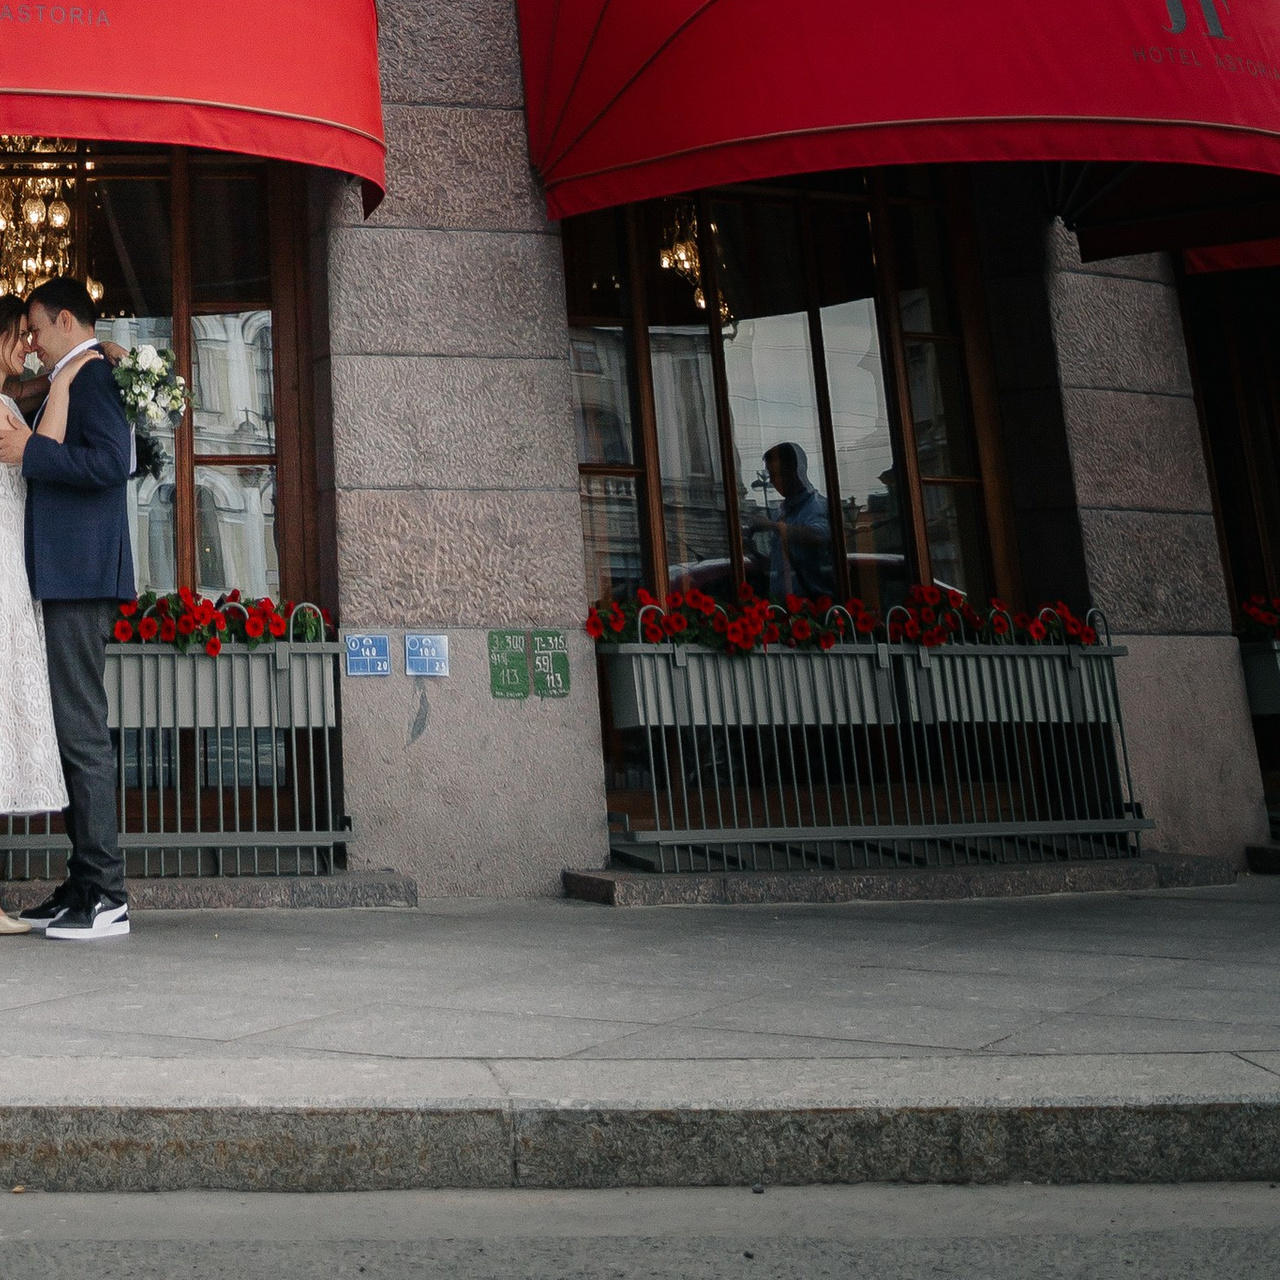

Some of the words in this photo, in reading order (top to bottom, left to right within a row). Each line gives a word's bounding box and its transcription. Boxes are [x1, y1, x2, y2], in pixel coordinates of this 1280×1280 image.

[0, 4, 111, 27] ASTORIA
[1131, 46, 1202, 67] HOTEL
[377, 661, 388, 671] 20
